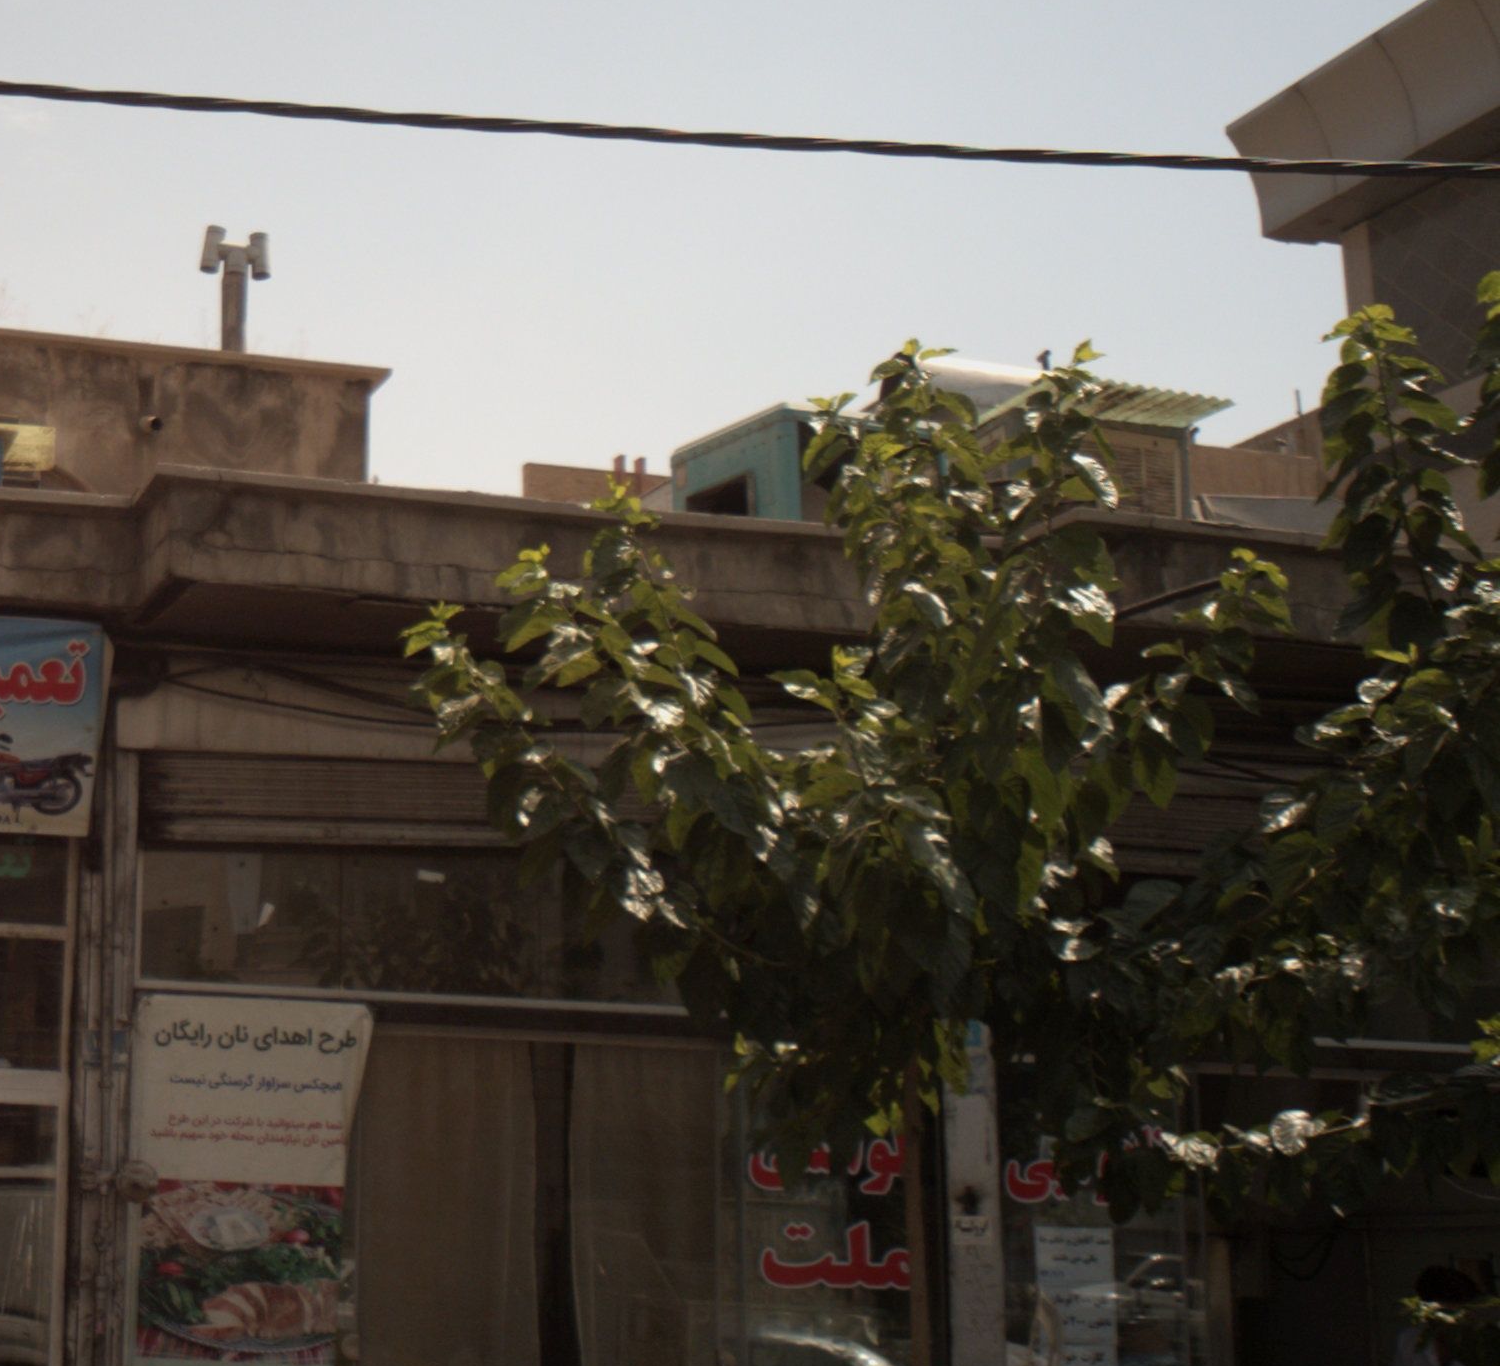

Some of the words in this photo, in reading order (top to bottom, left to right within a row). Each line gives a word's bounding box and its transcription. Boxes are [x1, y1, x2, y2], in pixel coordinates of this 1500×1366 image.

[154, 1019, 212, 1048] رایگان
[217, 1024, 249, 1049] نان
[254, 1027, 313, 1051] اهدای
[318, 1028, 357, 1054] طرح
